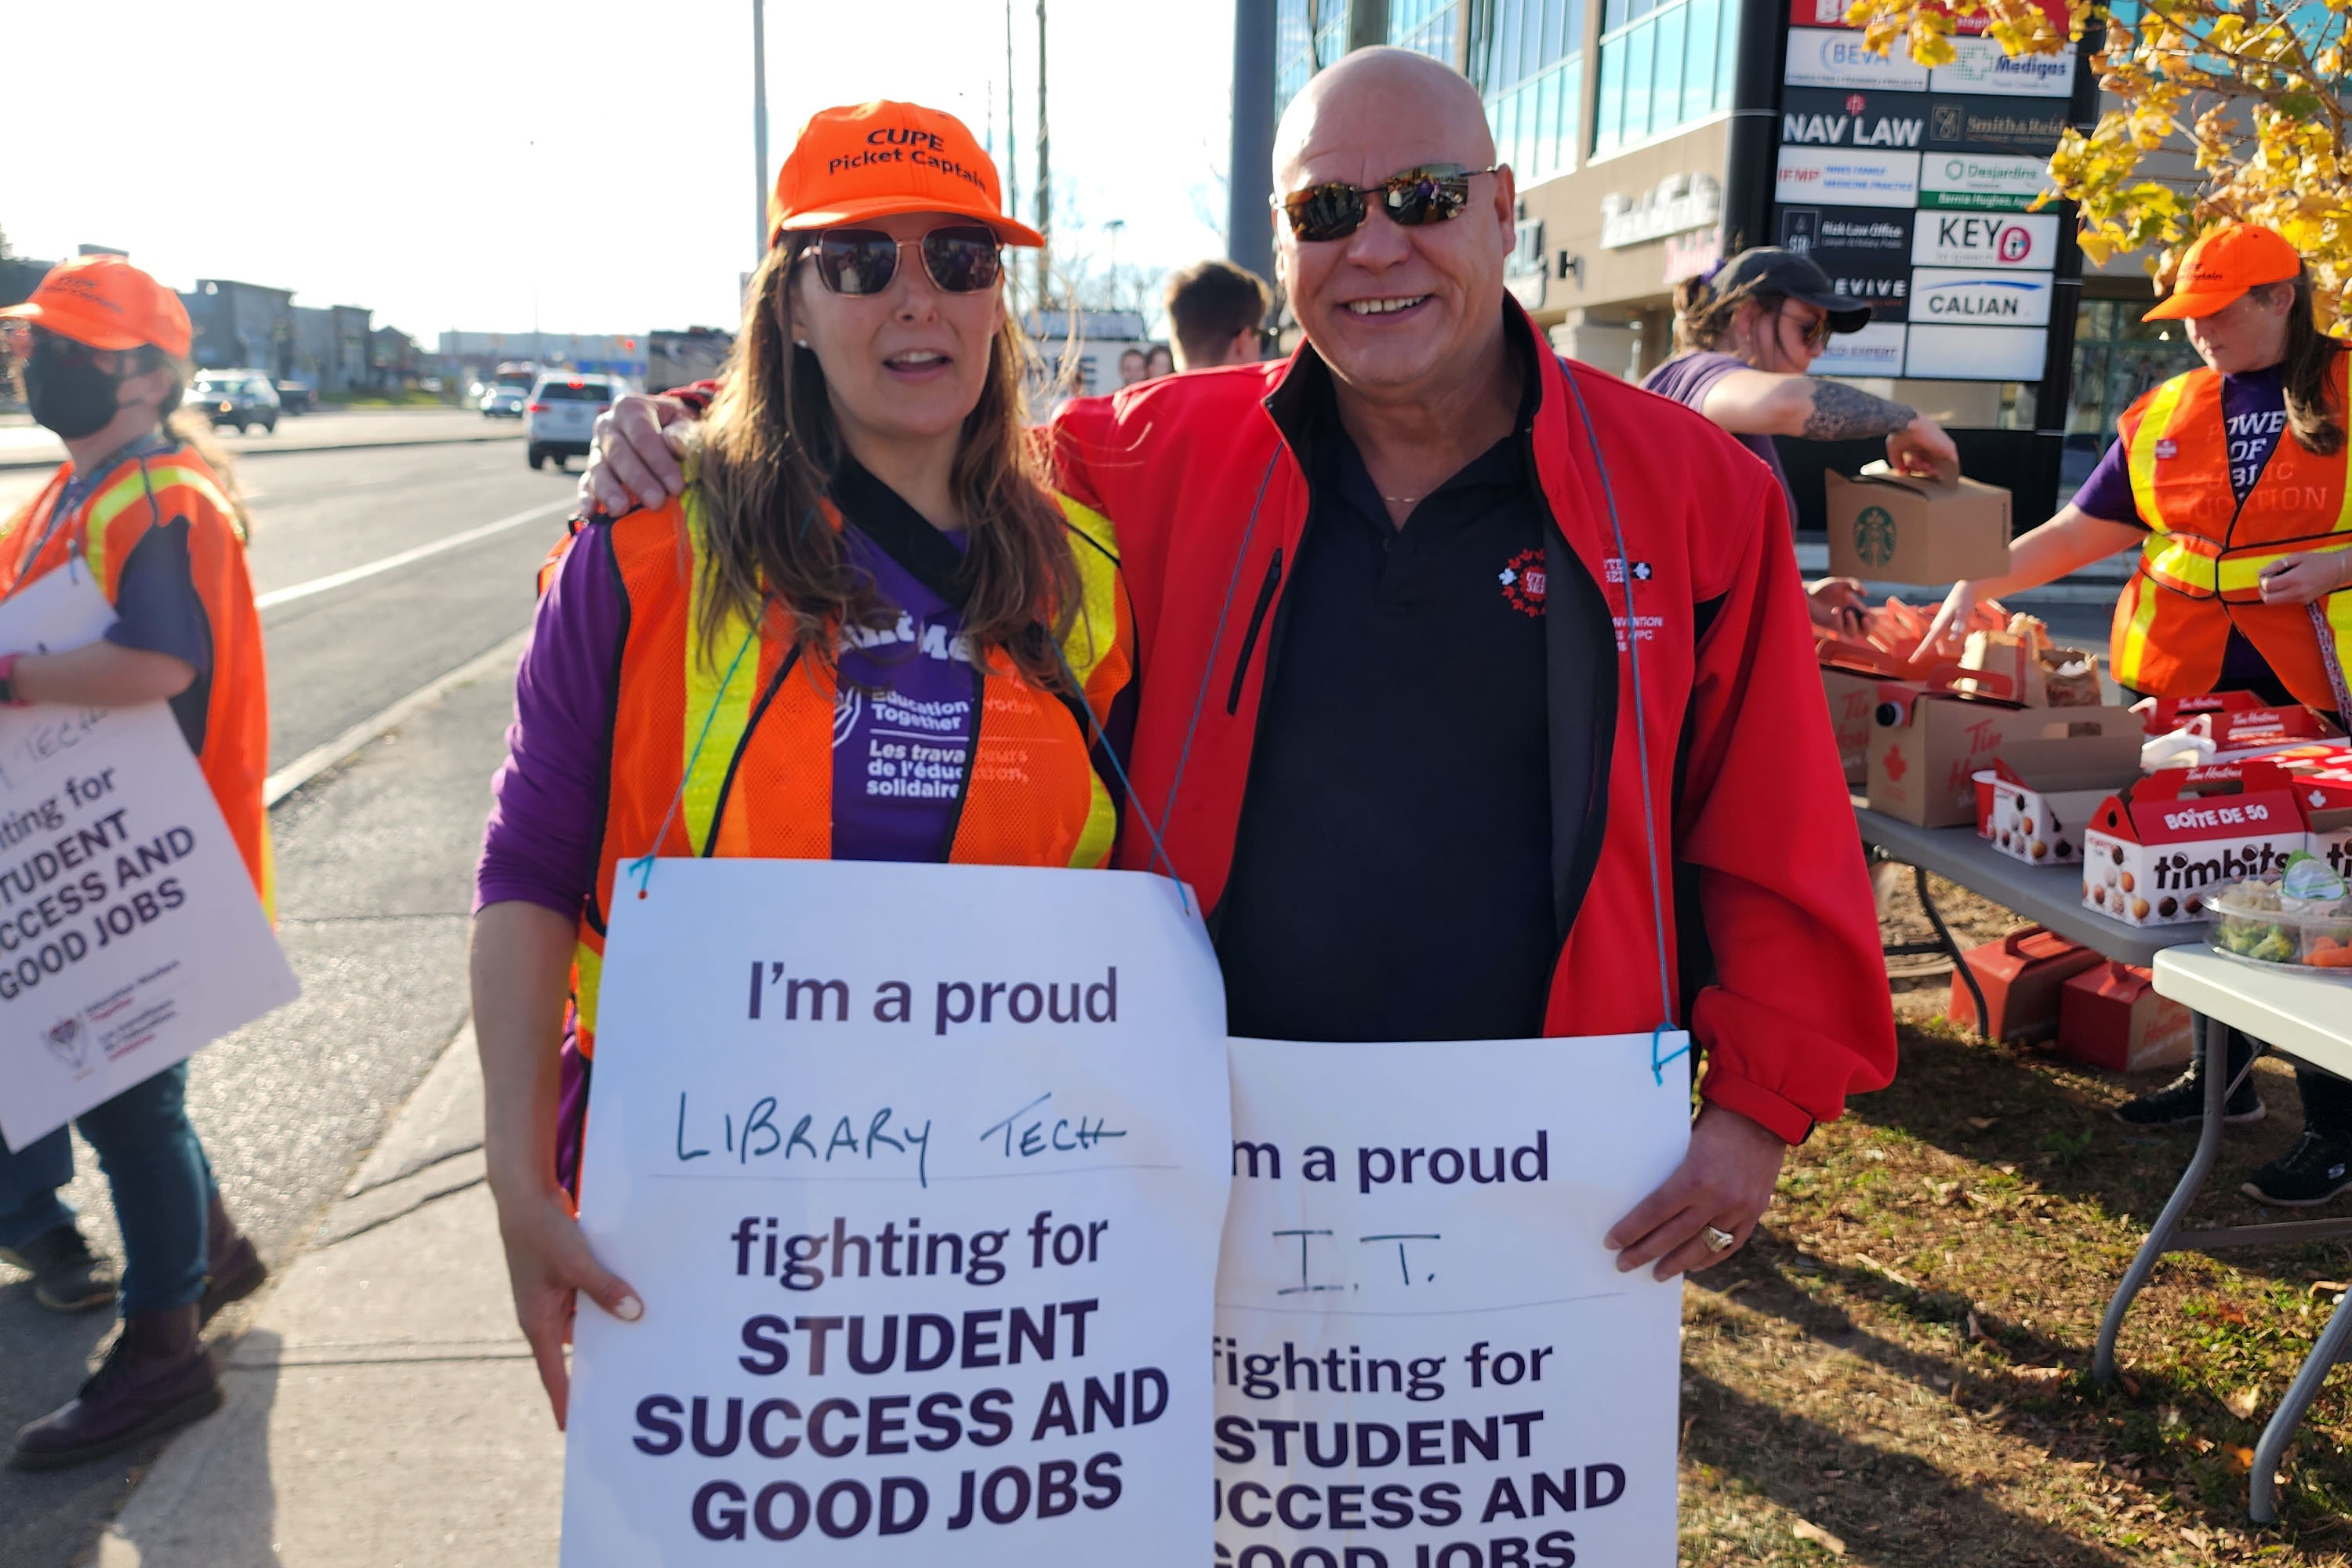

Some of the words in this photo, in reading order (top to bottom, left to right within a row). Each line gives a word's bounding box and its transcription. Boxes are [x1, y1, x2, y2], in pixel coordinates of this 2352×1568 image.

[1995, 56, 2067, 79] Medigas
[867, 128, 946, 152] CUPE
[1783, 113, 1846, 144] NAV
[1853, 116, 1924, 147] LAW
[828, 147, 904, 175] Picket
[1778, 167, 1820, 183] IFMP
[1968, 163, 2037, 180] Desjardins
[1835, 278, 1907, 298] EVIVE
[1929, 295, 2019, 315] CALIAN
[2230, 437, 2267, 463] OF
[1612, 616, 1664, 626] NVNTION
[870, 702, 962, 731] Together
[872, 687, 971, 717] Education
[869, 739, 907, 759] Les
[1965, 718, 2002, 754] Tim
[867, 757, 896, 777] de
[2205, 764, 2243, 779] Hortons
[866, 778, 960, 799] solidaire
[0, 797, 64, 851] ting
[66, 766, 115, 808] for
[2164, 808, 2219, 830] BOÎTE
[2220, 806, 2245, 825] DE
[2245, 804, 2269, 822] 50
[0, 807, 128, 905] TUDENT
[2154, 842, 2290, 891] timbits
[0, 871, 107, 952] CCESS
[116, 826, 195, 889] AND
[0, 931, 87, 1000] GOOD
[94, 877, 186, 949] JOBS
[873, 978, 912, 1023] a
[935, 966, 1118, 1036] proud
[676, 1091, 931, 1189] LIBRARY
[980, 1092, 1127, 1159] TECH
[1301, 1145, 1336, 1182] a
[1358, 1130, 1548, 1194] proud
[731, 1216, 1010, 1292] fighting
[1027, 1210, 1109, 1269] for
[739, 1299, 1099, 1377] STUDENT
[1465, 1341, 1554, 1388] for
[631, 1388, 1014, 1459] SUCCESS
[1031, 1367, 1171, 1443] AND
[1214, 1410, 1544, 1468] STUDENT
[691, 1476, 931, 1544] GOOD
[947, 1452, 1123, 1531] JOBS
[1214, 1478, 1461, 1530] CCESS
[1479, 1462, 1626, 1523] AND
[1214, 1541, 1388, 1568] OOD
